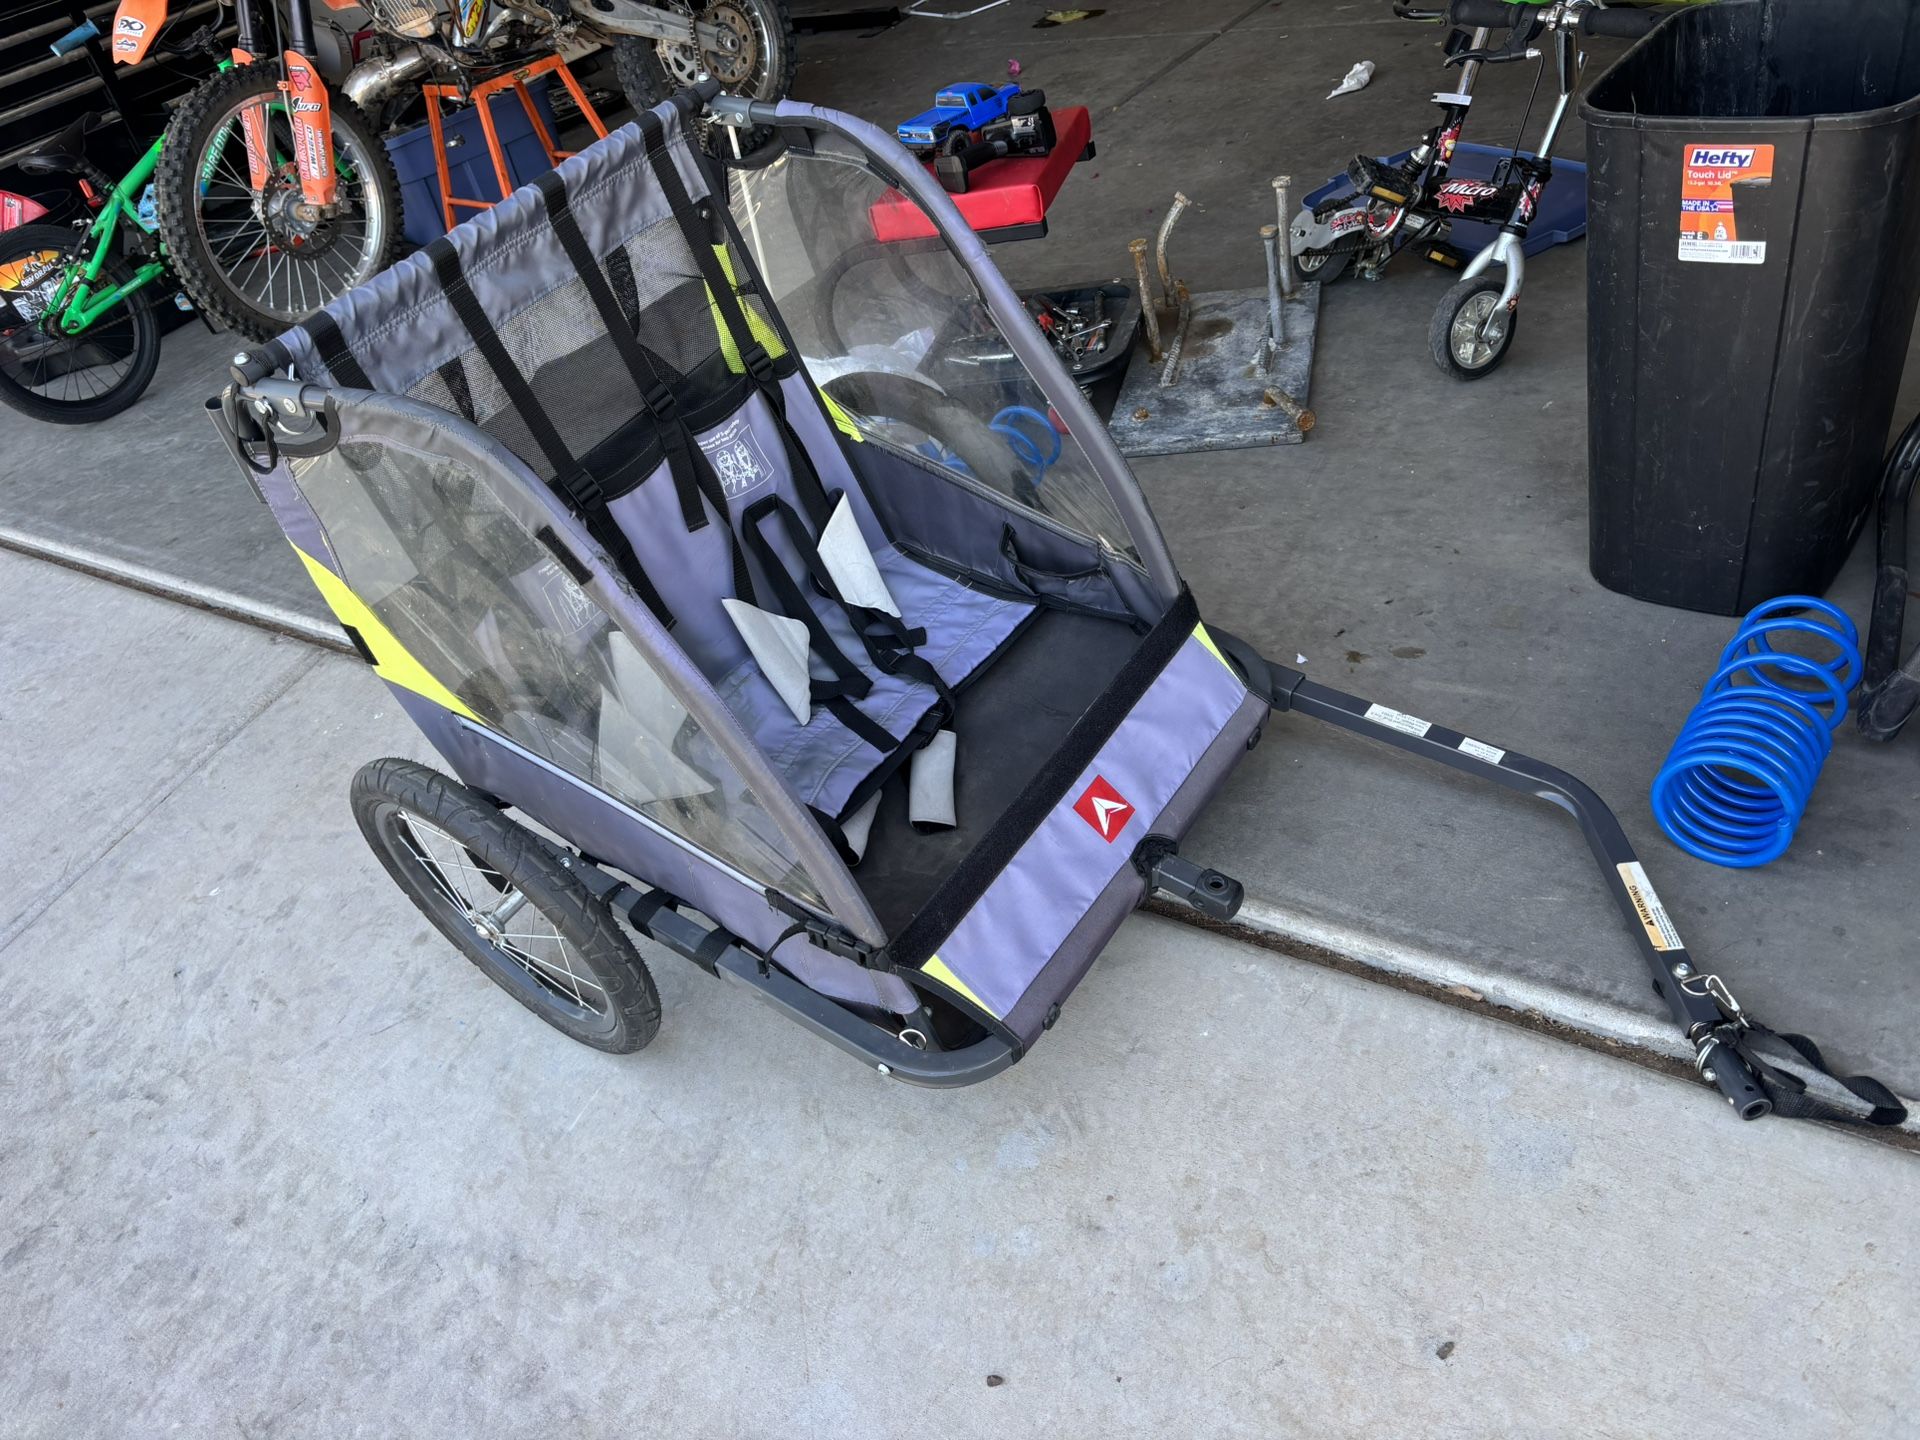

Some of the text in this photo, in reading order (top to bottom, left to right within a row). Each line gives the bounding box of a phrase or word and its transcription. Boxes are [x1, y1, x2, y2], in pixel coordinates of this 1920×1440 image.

[1693, 151, 1750, 168] Hefty
[1687, 170, 1715, 179] Touch
[1443, 182, 1498, 197] Micro
[1629, 885, 1652, 921] WARNING
